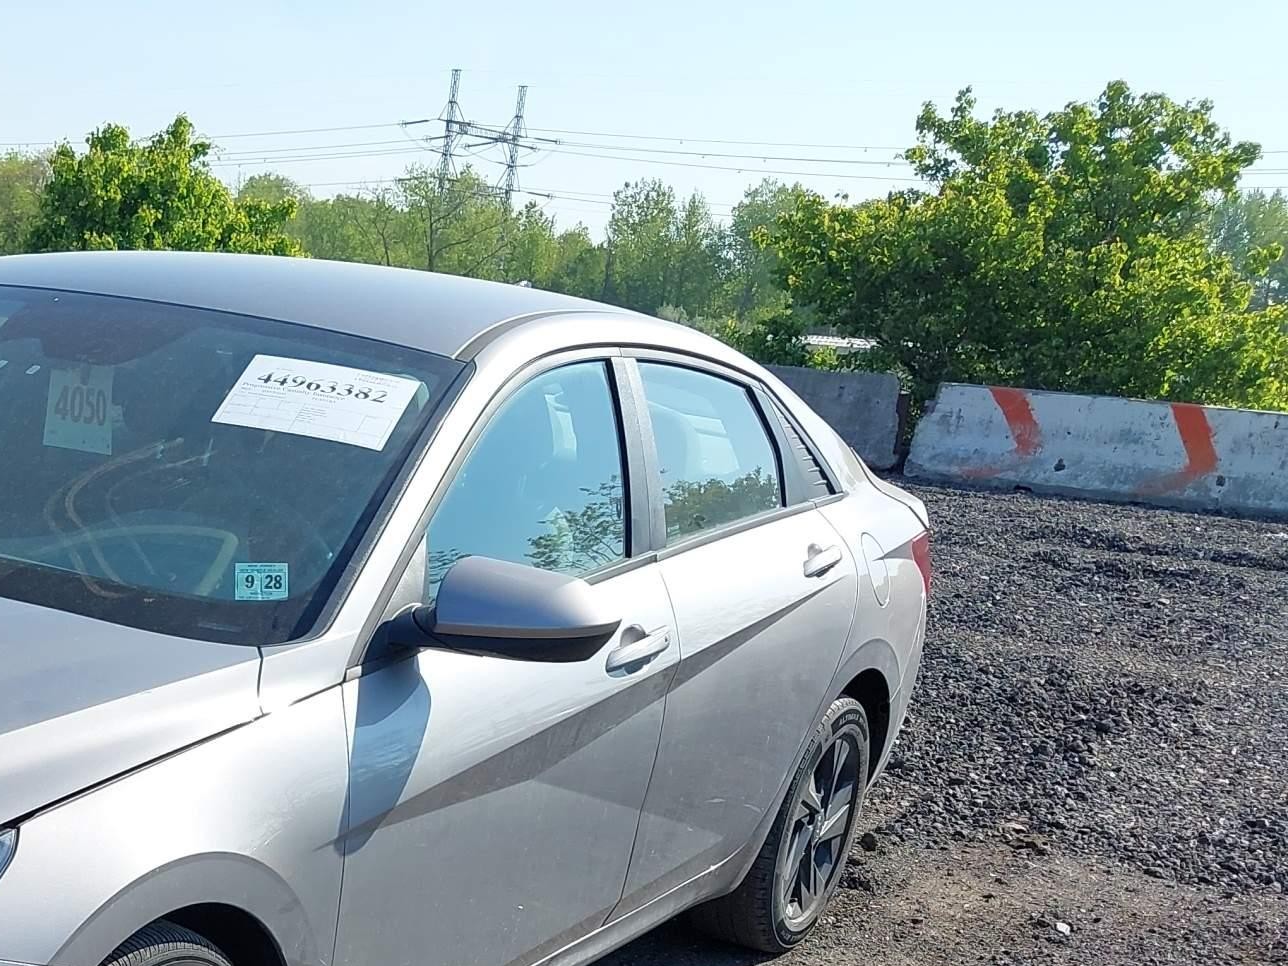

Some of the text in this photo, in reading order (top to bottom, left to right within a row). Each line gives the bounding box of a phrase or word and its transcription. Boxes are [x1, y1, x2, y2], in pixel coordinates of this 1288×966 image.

[257, 372, 389, 404] 44963382
[55, 386, 106, 426] 4050
[245, 575, 282, 589] 9 28
